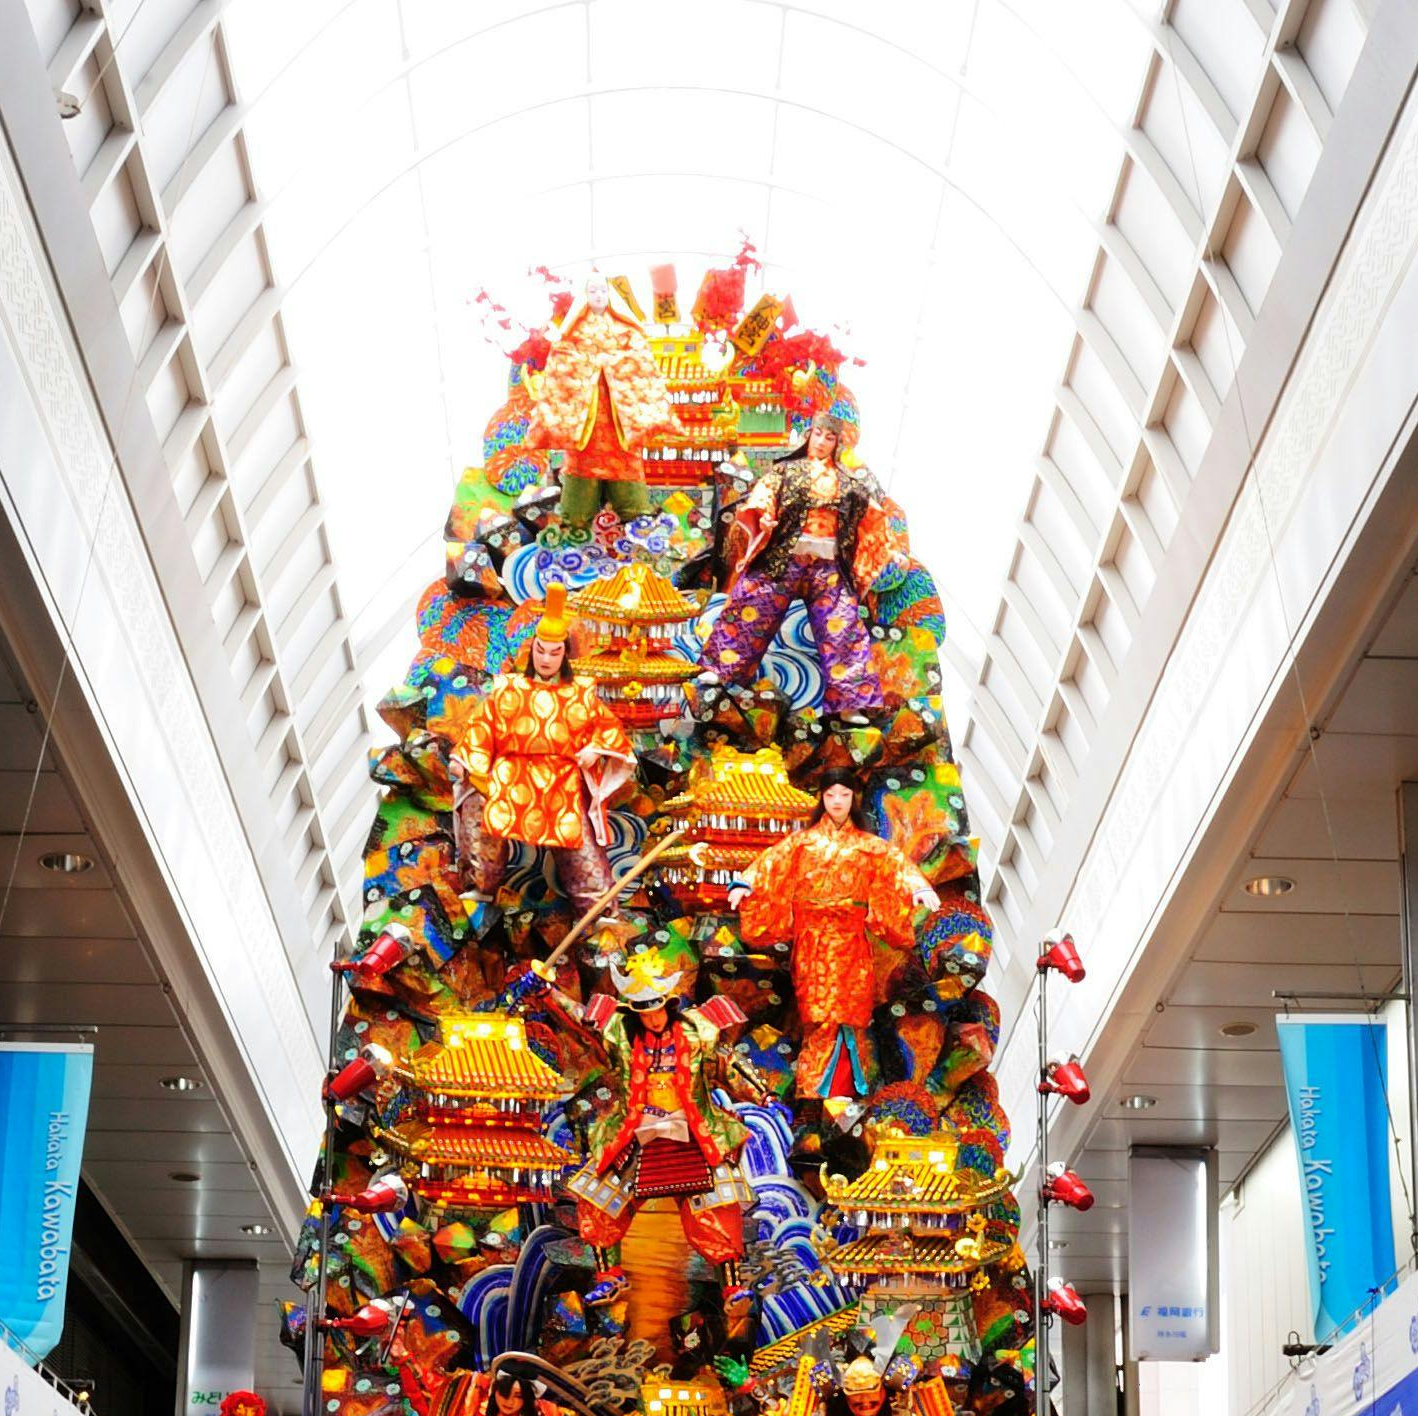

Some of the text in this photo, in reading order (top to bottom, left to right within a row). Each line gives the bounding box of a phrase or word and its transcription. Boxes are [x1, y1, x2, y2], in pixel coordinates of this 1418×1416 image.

[1298, 1085, 1321, 1150] Hakata
[37, 1111, 72, 1302] Hakata Kawabata
